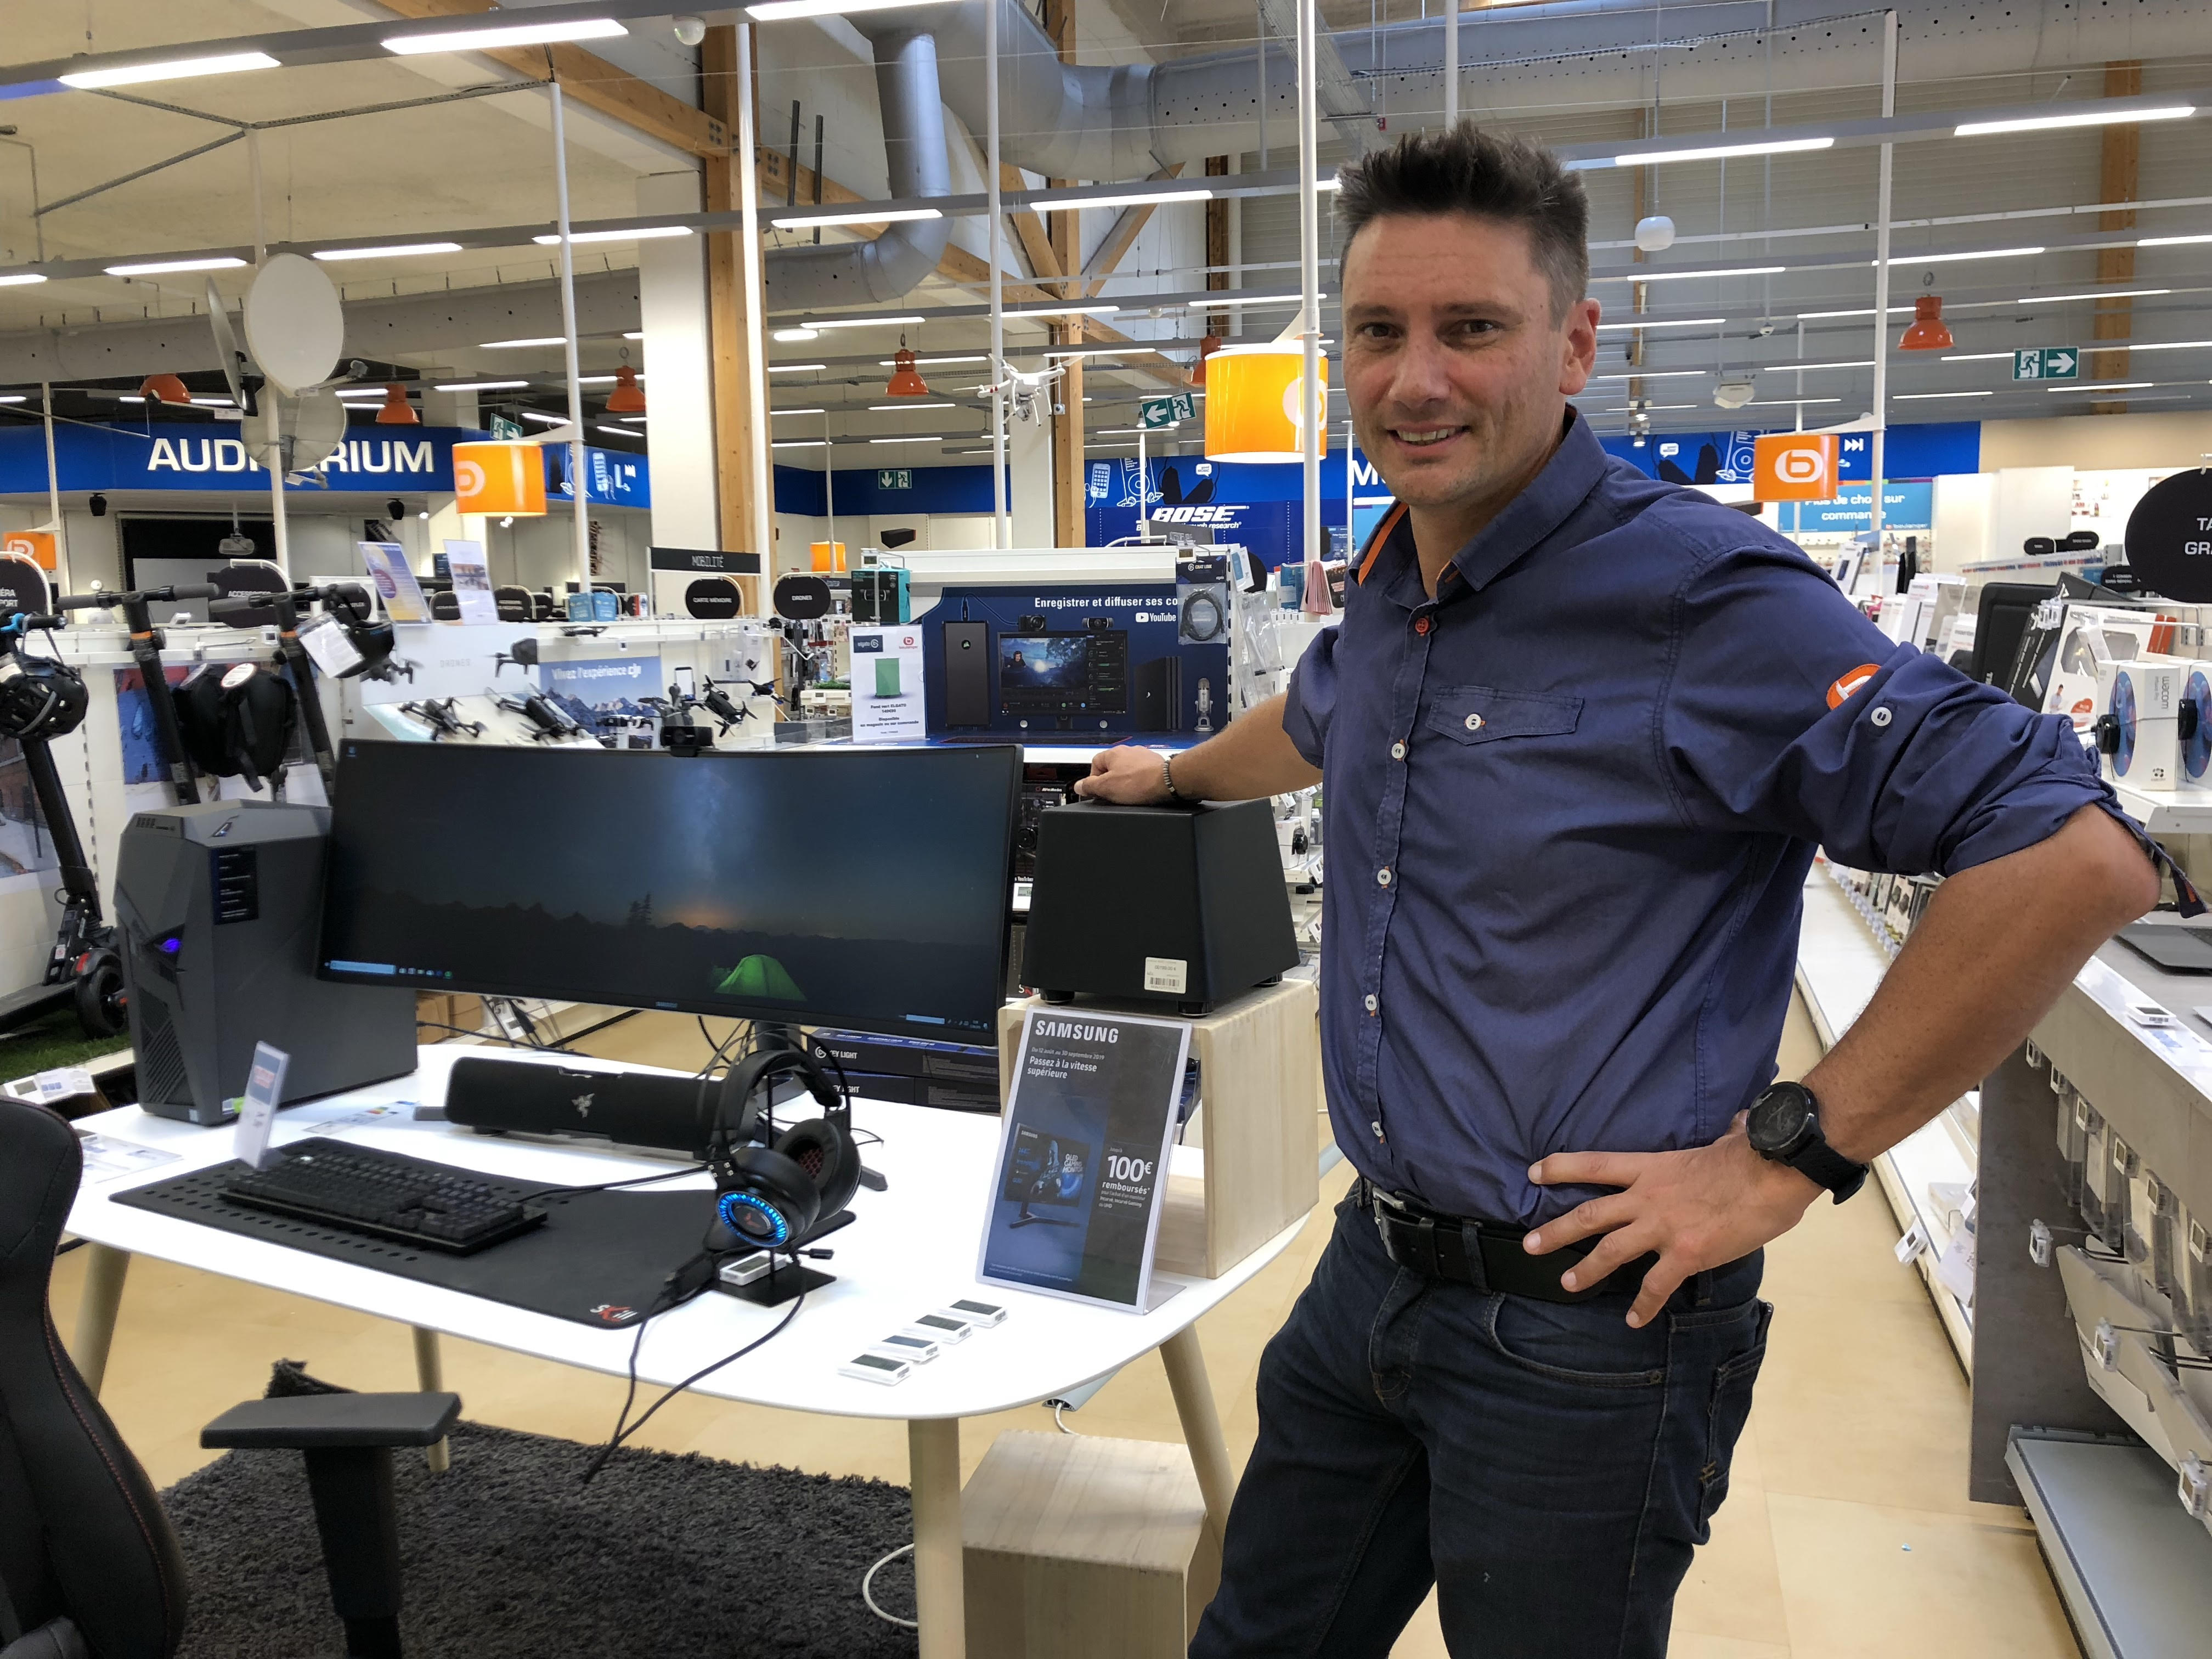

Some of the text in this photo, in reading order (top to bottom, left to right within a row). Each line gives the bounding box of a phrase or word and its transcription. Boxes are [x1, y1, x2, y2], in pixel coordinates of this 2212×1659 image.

[147, 438, 435, 473] AUDRIUM
[1351, 460, 1386, 486] M
[1850, 494, 1872, 505] cho
[1883, 494, 1906, 504] sur
[1151, 505, 1247, 522] BOSE
[1821, 511, 1887, 521] commane
[2185, 541, 2212, 555] GR
[1034, 596, 1178, 610] Enregistrer et diffuser ses co
[1149, 612, 1176, 622] YouTube
[1035, 1020, 1119, 1043] SAMSUNG
[840, 1051, 858, 1059] LIGHT
[1029, 1056, 1097, 1072] Passez à la vitesse
[1027, 1067, 1068, 1079] supérieure
[1108, 1155, 1153, 1182] 100€
